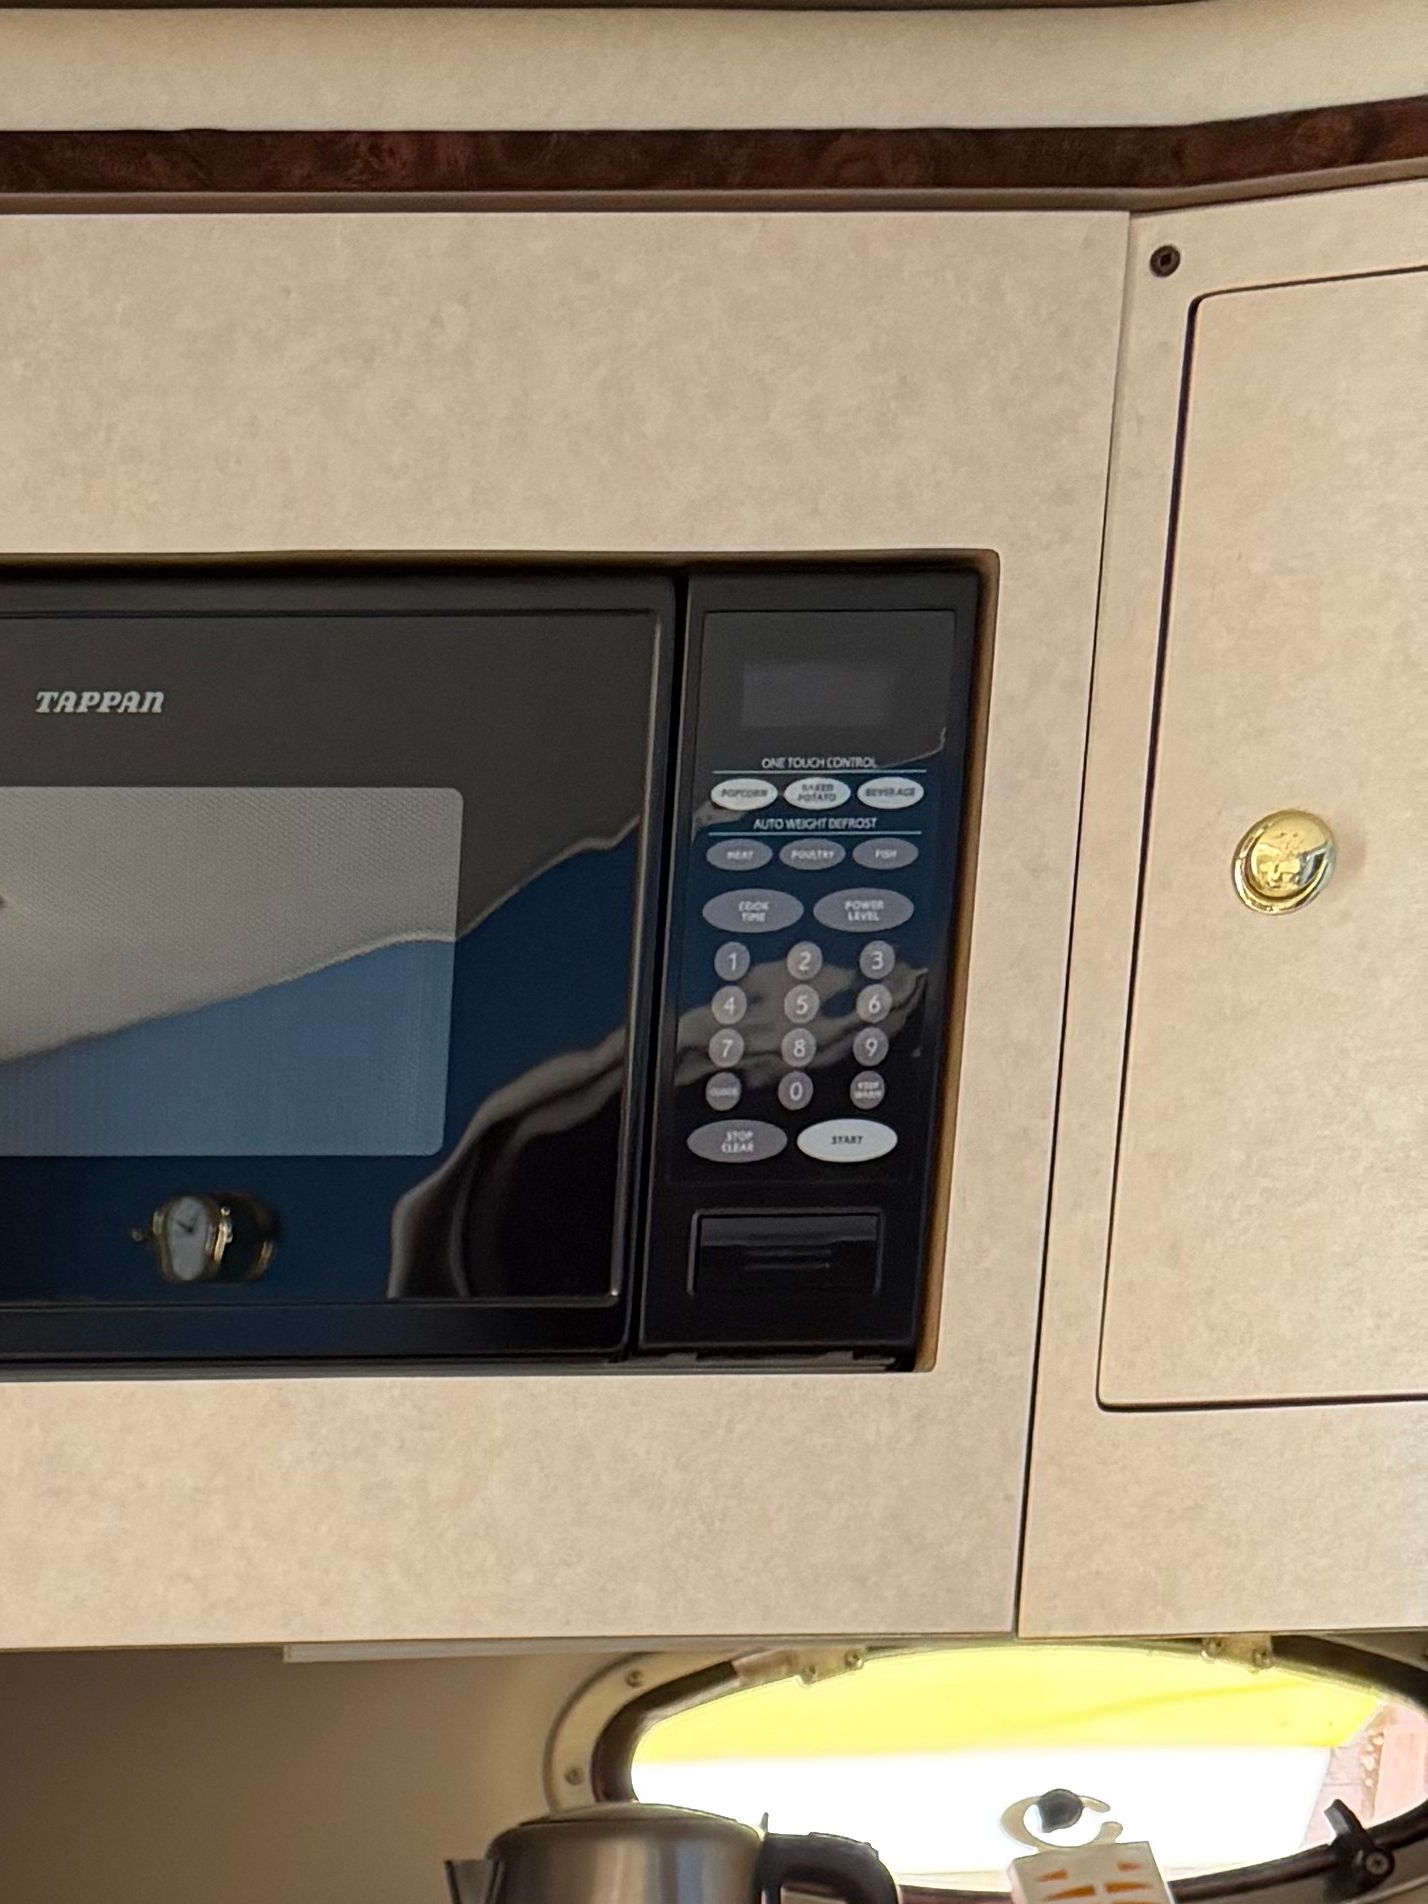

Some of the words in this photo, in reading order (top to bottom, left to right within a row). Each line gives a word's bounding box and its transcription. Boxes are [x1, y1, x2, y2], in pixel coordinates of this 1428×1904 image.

[35, 690, 165, 713] TAPPAN
[761, 758, 786, 769] ONE
[788, 757, 825, 769] TOUCH
[826, 756, 878, 768] CONTROL
[721, 788, 768, 798] POPCORN
[865, 787, 916, 797] BEVERAGE
[753, 818, 784, 830] AUTO
[786, 817, 827, 830] WEIGHT
[828, 817, 877, 829] DEFROST
[727, 850, 754, 860] MEAT
[791, 850, 834, 860] POULTRY
[875, 849, 898, 859] FISH
[738, 901, 769, 911] COOK
[844, 900, 884, 911] POWER
[741, 912, 766, 922] TIME
[848, 911, 880, 922] LEVEL
[728, 954, 738, 970] 1
[799, 953, 811, 969] 2
[871, 952, 884, 968] 3
[723, 997, 736, 1014] 4
[795, 997, 808, 1014] 5
[868, 996, 881, 1013] 6
[721, 1040, 733, 1057] 7
[793, 1040, 806, 1057] 8
[865, 1039, 878, 1056] 9
[789, 1082, 803, 1100] 0
[725, 1131, 754, 1142] STOP
[831, 1135, 864, 1145] START
[720, 1142, 754, 1153] CLEAR
